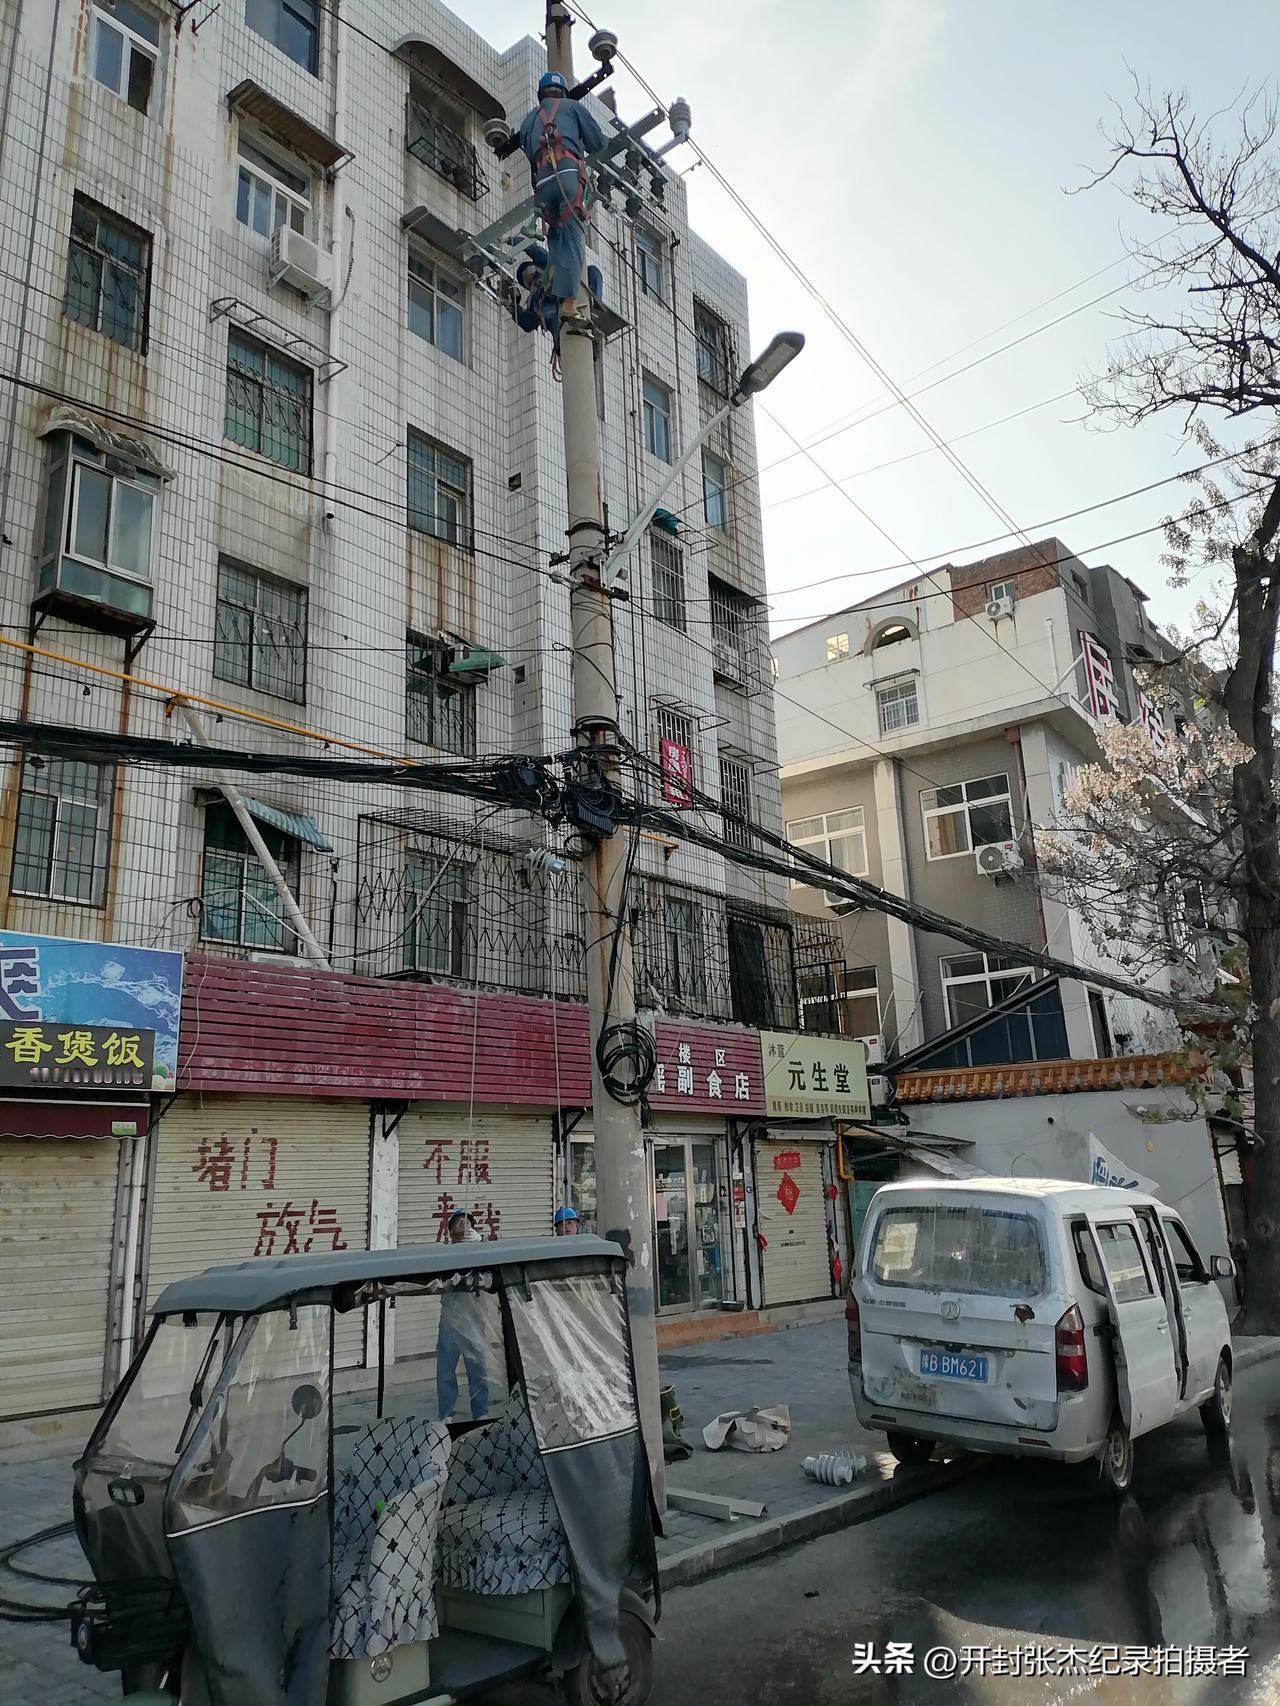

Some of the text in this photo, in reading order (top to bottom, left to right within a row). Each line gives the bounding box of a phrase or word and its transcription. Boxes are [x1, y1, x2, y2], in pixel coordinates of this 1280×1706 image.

[5, 1027, 145, 1068] 香煲饭
[787, 1061, 851, 1093] 元生堂
[191, 1130, 278, 1191] 堵门
[422, 1139, 492, 1185] 不服
[254, 1199, 348, 1257] 放气
